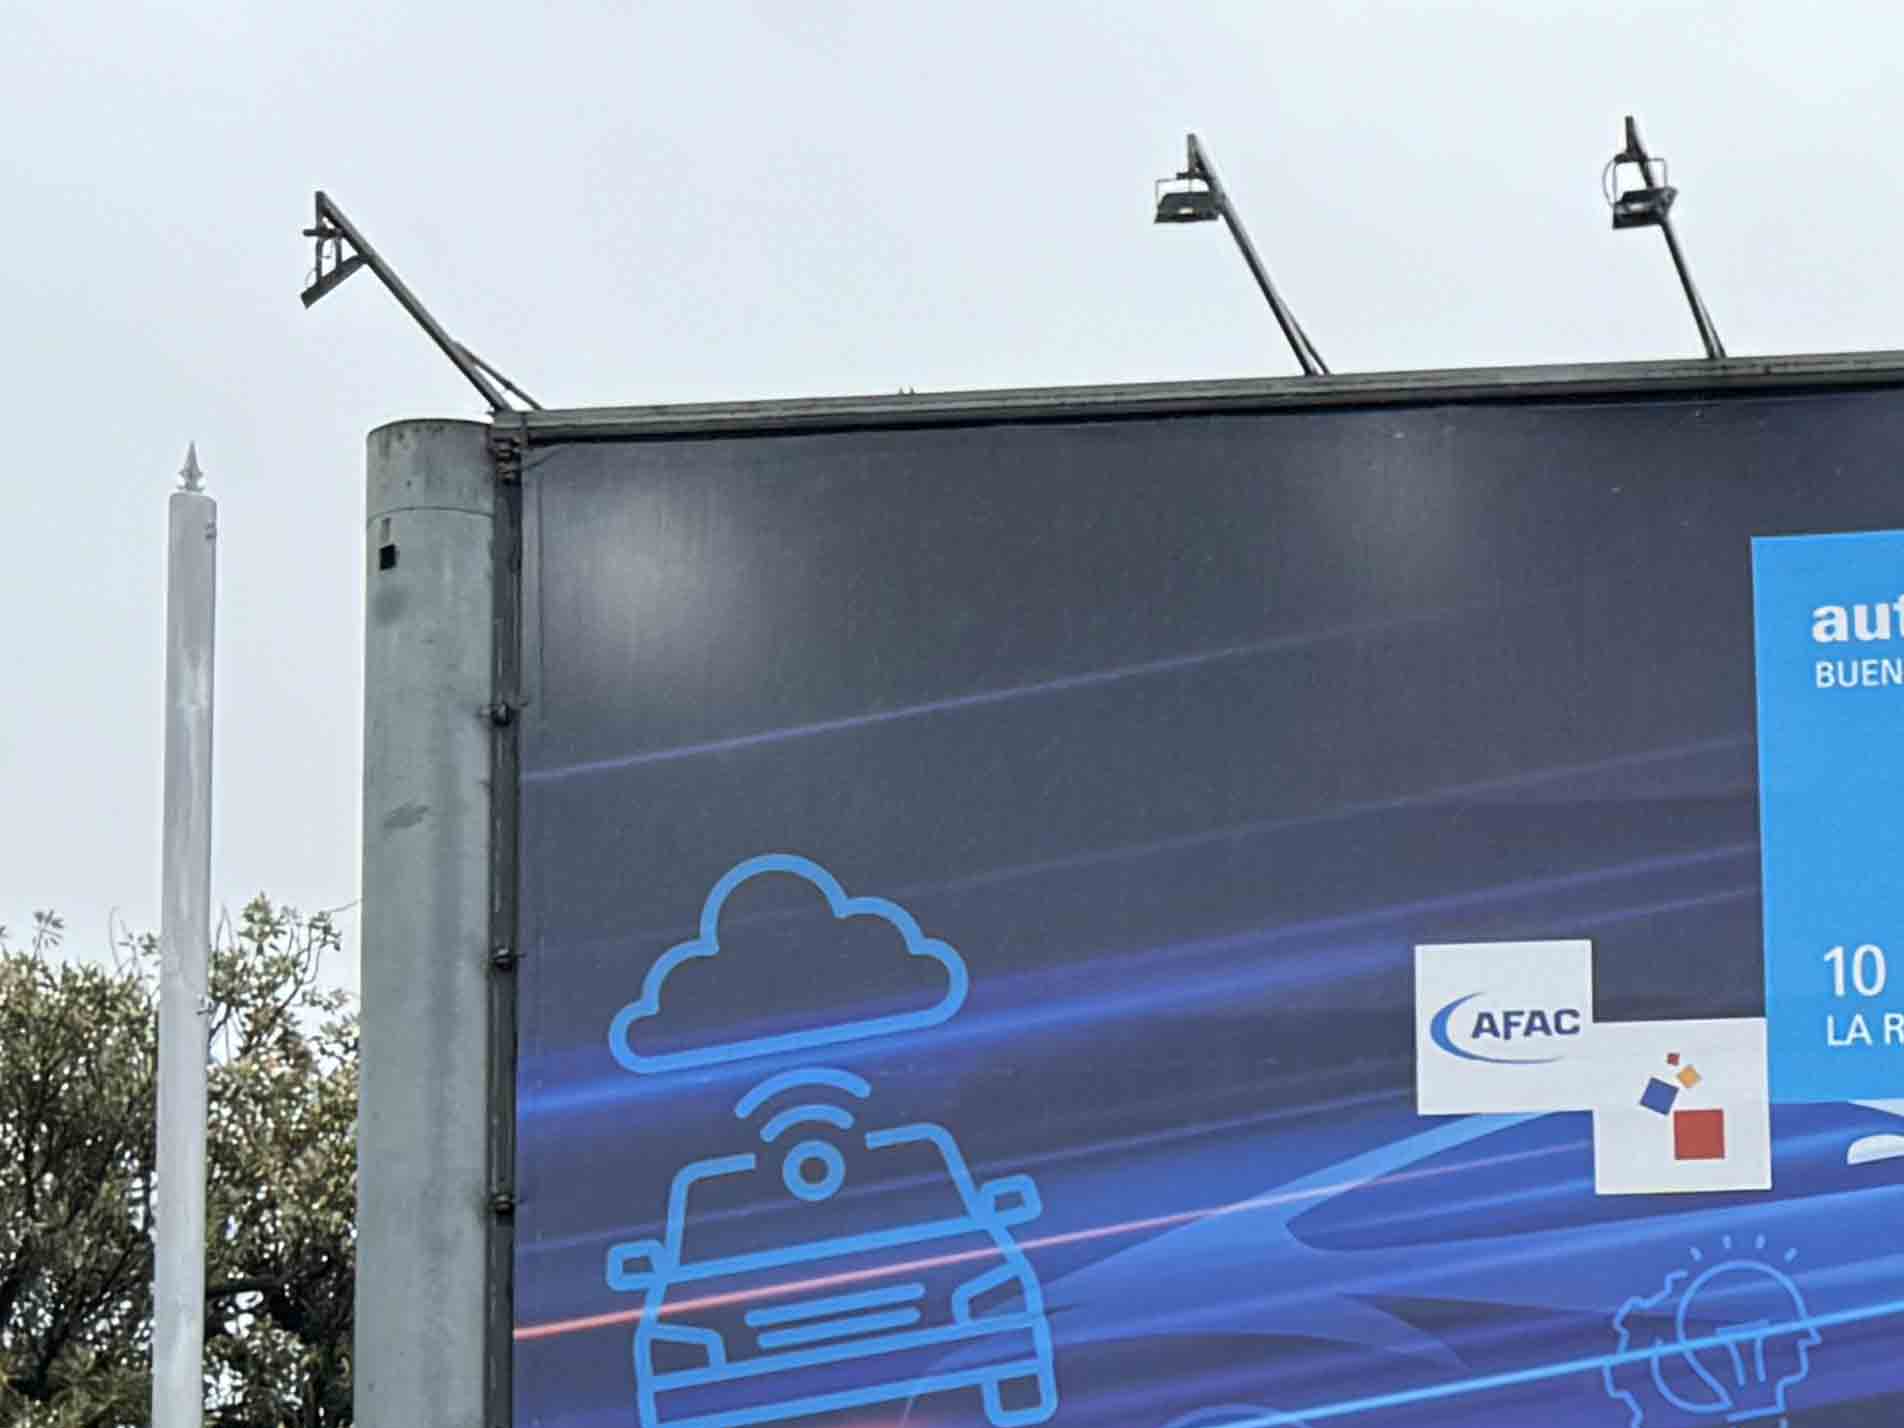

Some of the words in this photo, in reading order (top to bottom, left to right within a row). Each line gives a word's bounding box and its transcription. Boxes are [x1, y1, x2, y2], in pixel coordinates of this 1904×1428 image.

[1823, 943, 1888, 998] 10
[1471, 1008, 1582, 1041] AFAC
[1826, 1012, 1873, 1047] LA
